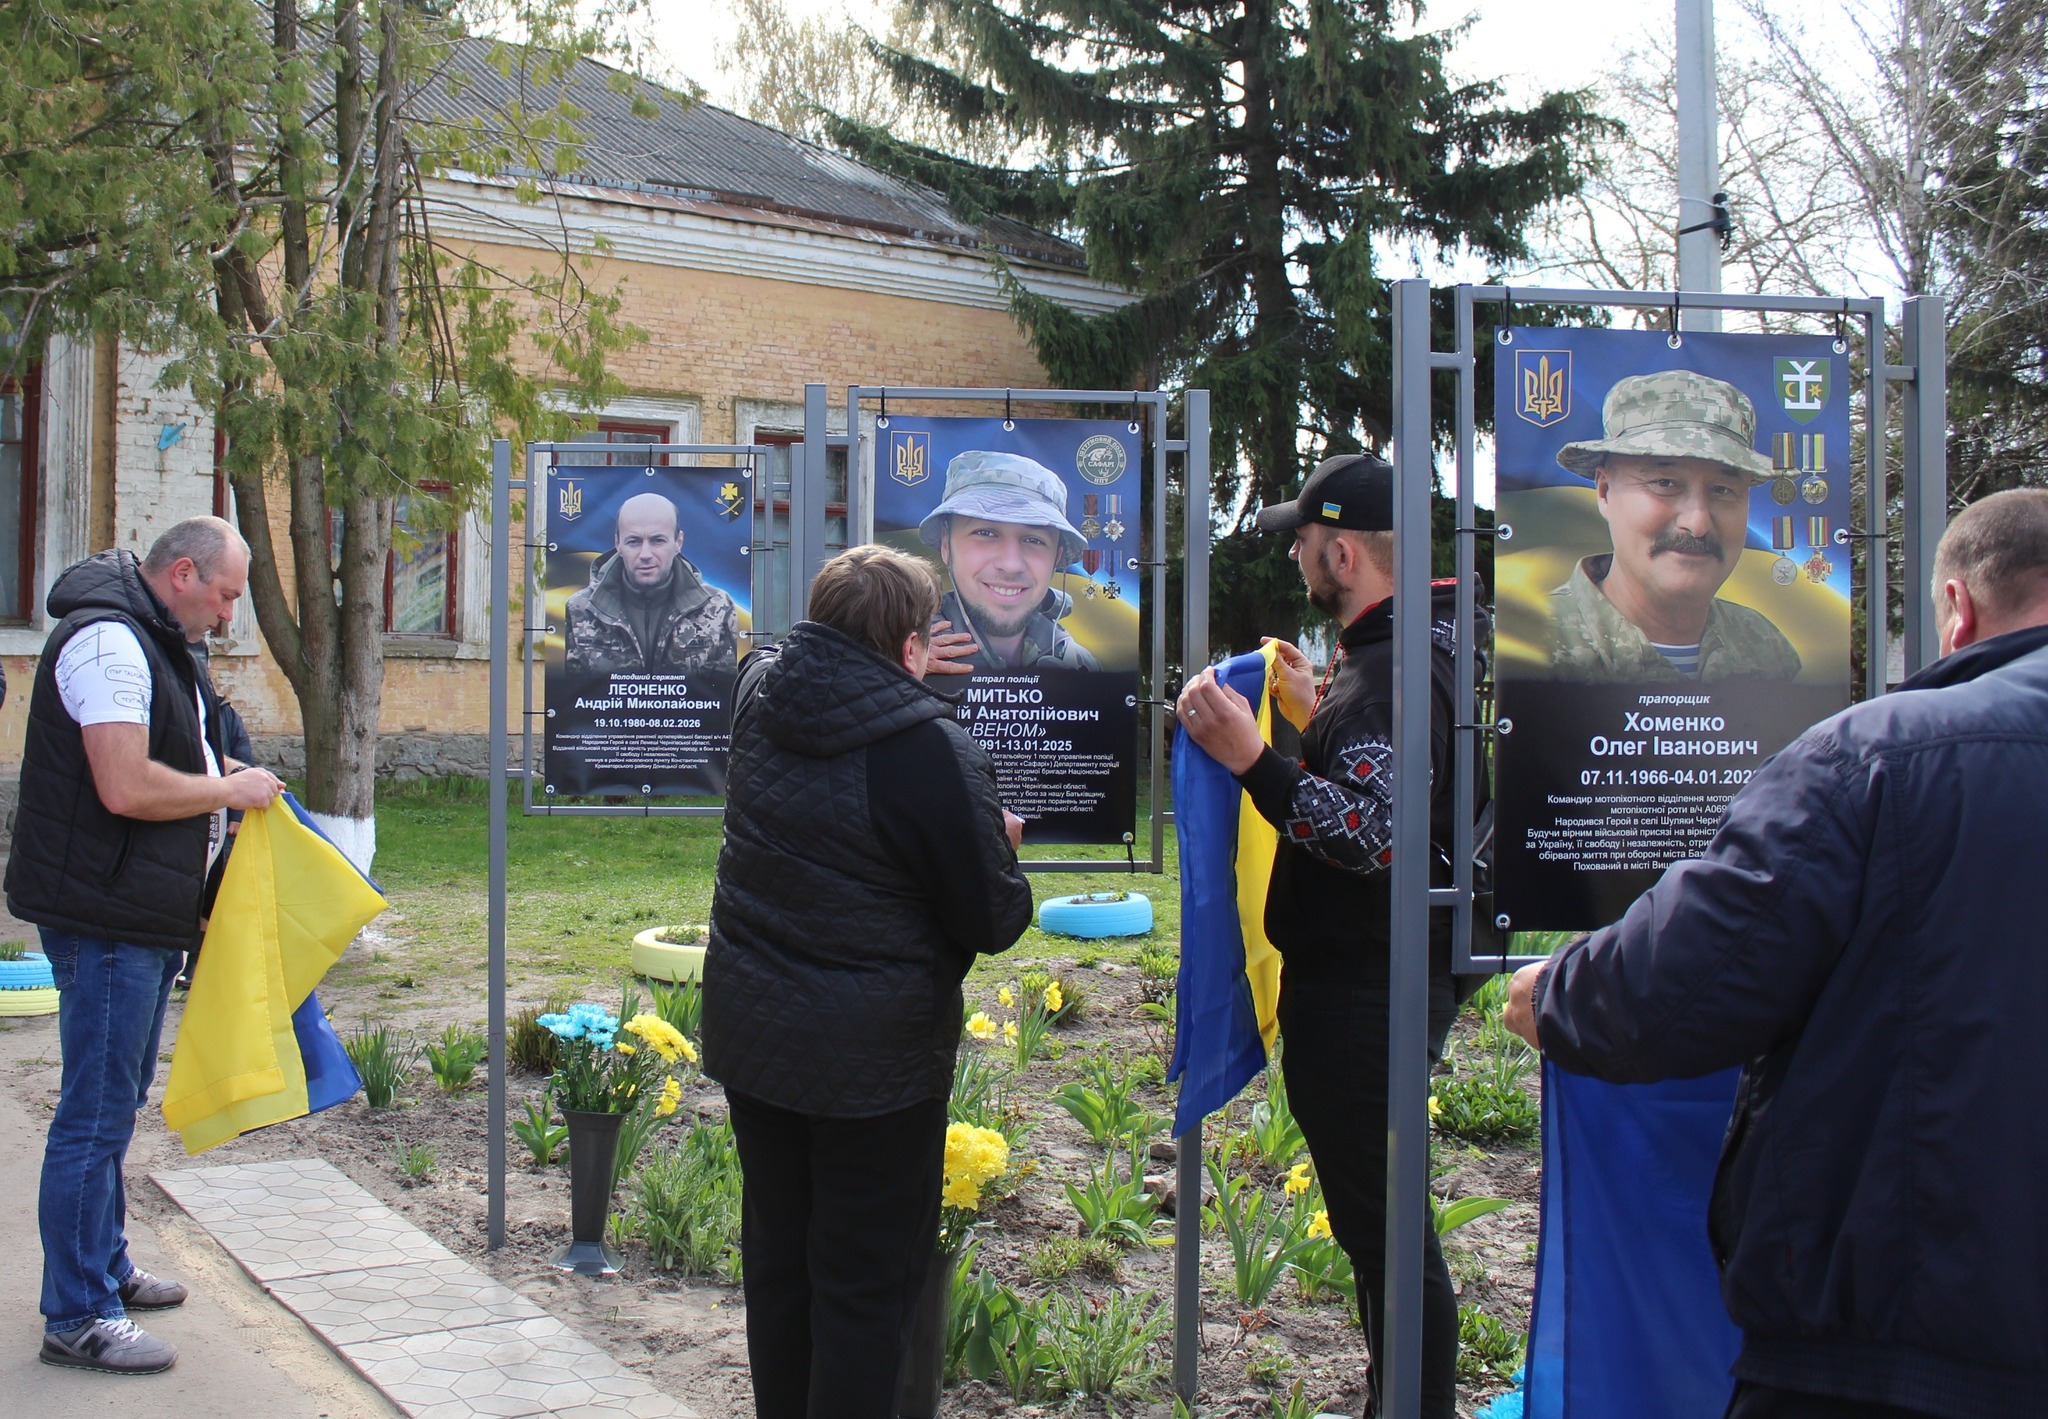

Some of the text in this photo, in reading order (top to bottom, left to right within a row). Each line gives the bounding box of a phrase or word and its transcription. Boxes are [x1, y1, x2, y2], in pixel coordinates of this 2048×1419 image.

[1112, 442, 1124, 458] ПОЛК
[972, 676, 1040, 684] капрал поліції
[608, 684, 687, 696] ЛЕОНЕНКО
[967, 689, 1043, 704] МИТЬКО
[1638, 694, 1711, 706] прапорщик
[574, 698, 720, 711] Андрій Миколайович
[976, 706, 1099, 721] Анатолійович
[594, 718, 701, 728] 19.10.1980-08.02.2026
[1624, 712, 1725, 732] Хоменко
[963, 723, 1047, 738] «ВЕНОМ»
[1590, 736, 1758, 756] Олег Іванович
[1580, 769, 1759, 785] 07.11.1966-04.01.202
[1548, 794, 1592, 805] Командир
[1595, 794, 1656, 804] мотопіхотного
[1658, 794, 1704, 804] відділення
[1611, 806, 1666, 816] мотопіхотної
[1667, 807, 1688, 816] роти
[1690, 806, 1702, 814] в/ч
[1555, 817, 1604, 827] Народився
[1606, 816, 1632, 827] Герой
[1640, 816, 1658, 825] селі
[1660, 816, 1694, 827] Шуляки
[1527, 829, 1560, 839] Будучи
[1562, 828, 1592, 838] вірним
[1594, 828, 1638, 836] військовій
[1640, 828, 1672, 837] присязі
[1538, 840, 1574, 850] Україну,
[1576, 840, 1583, 848] її
[1584, 840, 1620, 850] свободу
[1627, 839, 1686, 848] незалежність,
[1538, 850, 1580, 861] обірвало
[1610, 852, 1626, 861] при
[1627, 850, 1660, 861] обороні
[1663, 850, 1686, 858] міста
[1688, 850, 1706, 858] Бах
[1573, 862, 1622, 871] Похований
[1631, 862, 1650, 870] місті
